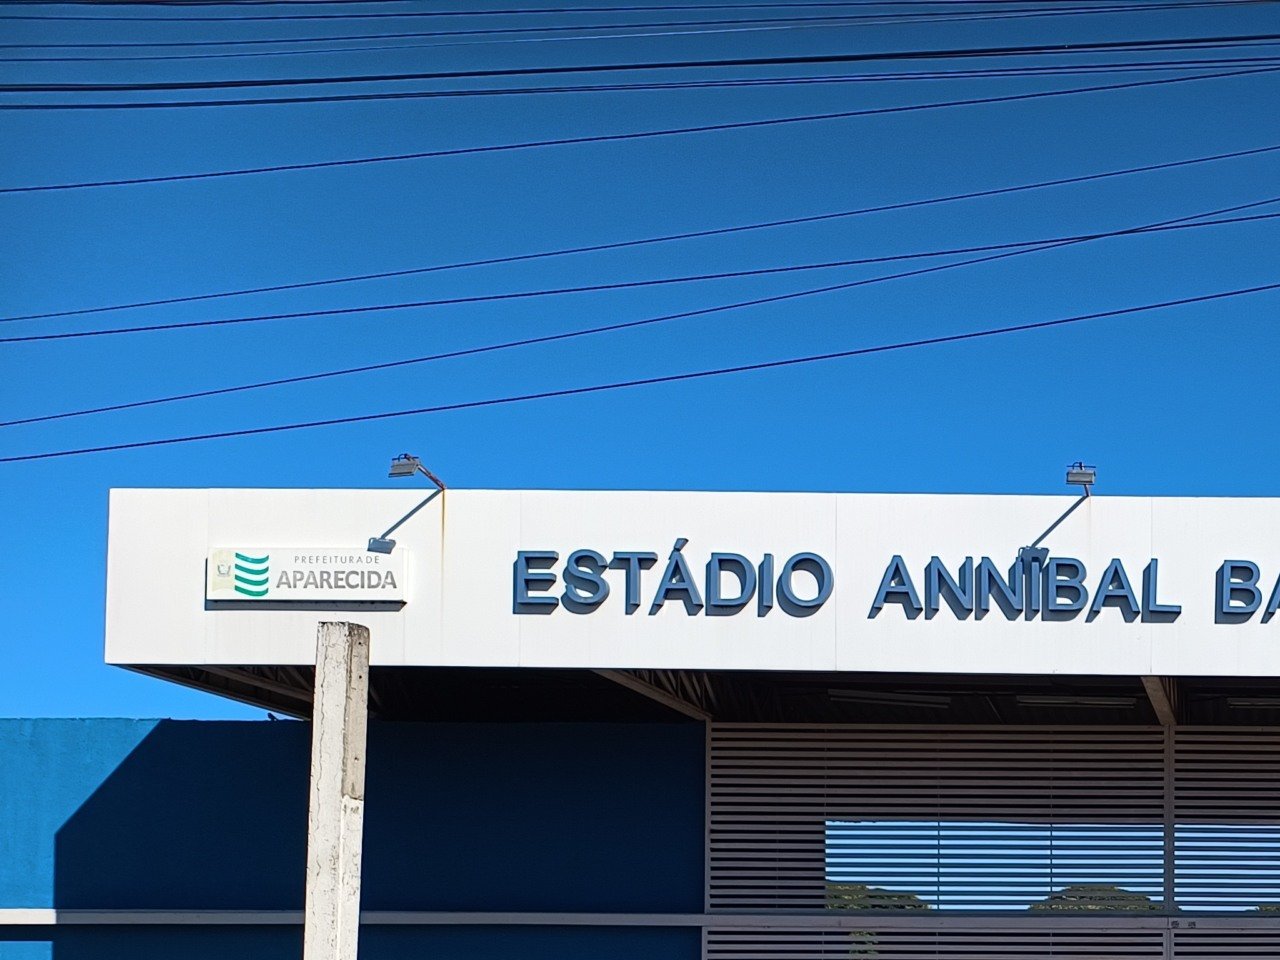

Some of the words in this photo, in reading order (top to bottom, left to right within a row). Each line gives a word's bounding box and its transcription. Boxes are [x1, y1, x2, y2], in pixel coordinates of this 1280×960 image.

[294, 555, 364, 564] PREFEITURA
[276, 570, 398, 589] APARECIDA
[512, 538, 834, 616] ESTÁDIO
[867, 552, 1181, 623] ANNIBAL
